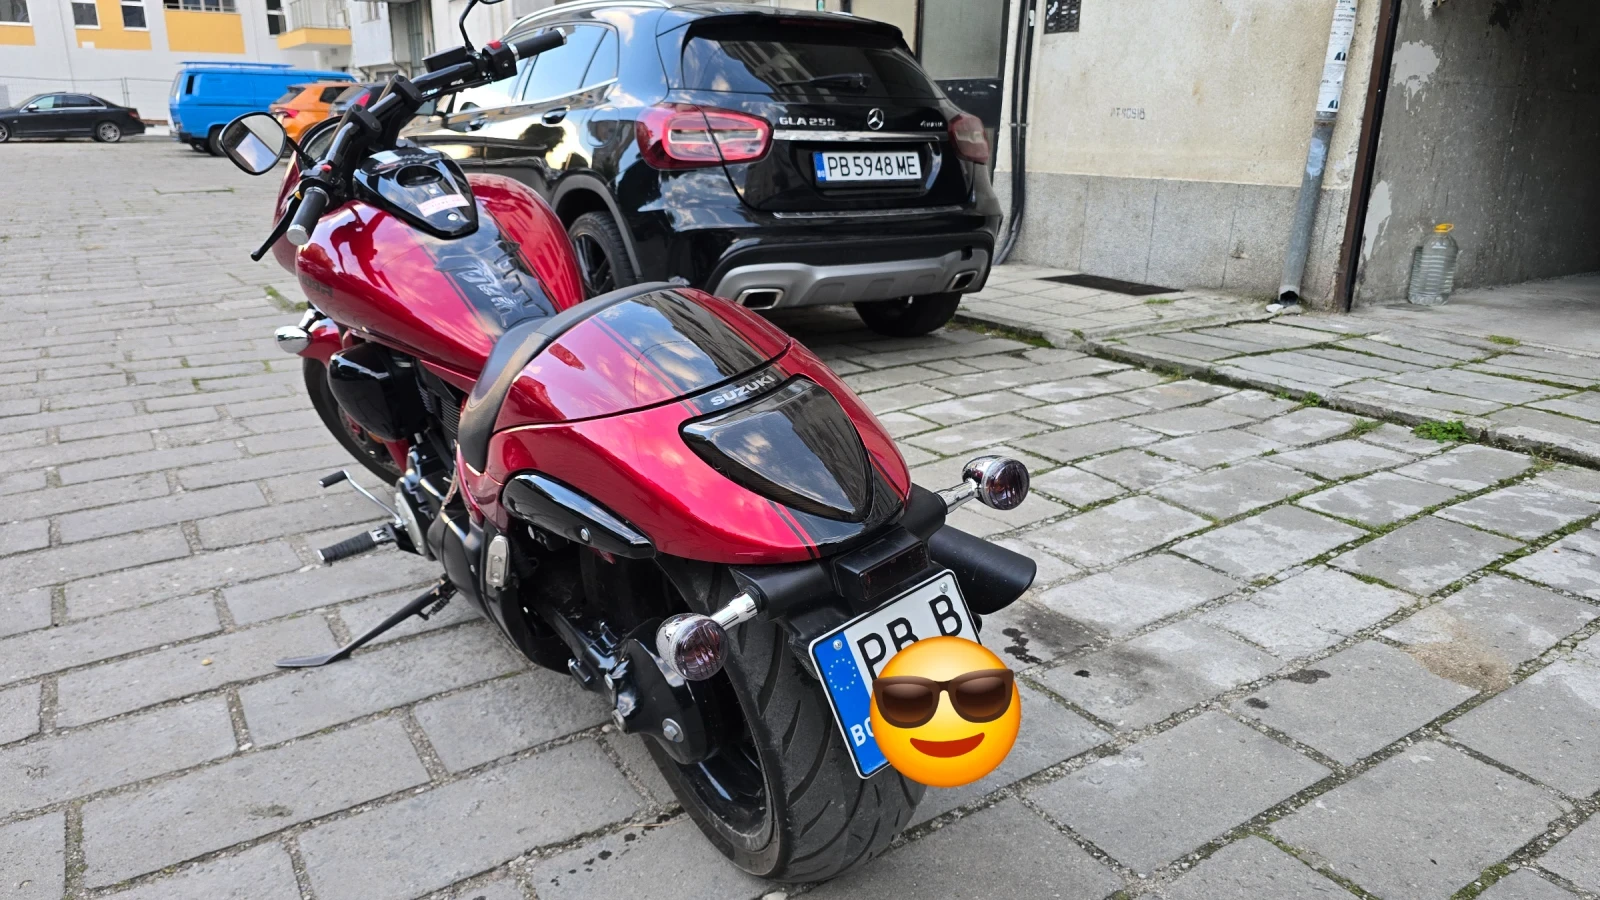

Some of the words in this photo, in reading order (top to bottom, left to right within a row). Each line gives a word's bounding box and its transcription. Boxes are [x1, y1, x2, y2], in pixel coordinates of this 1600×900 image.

[779, 116, 807, 126] GLA
[809, 117, 836, 127] 250
[827, 156, 850, 177] PB
[853, 156, 893, 177] 5948
[896, 155, 917, 176] ME
[710, 374, 776, 406] SUZUKI
